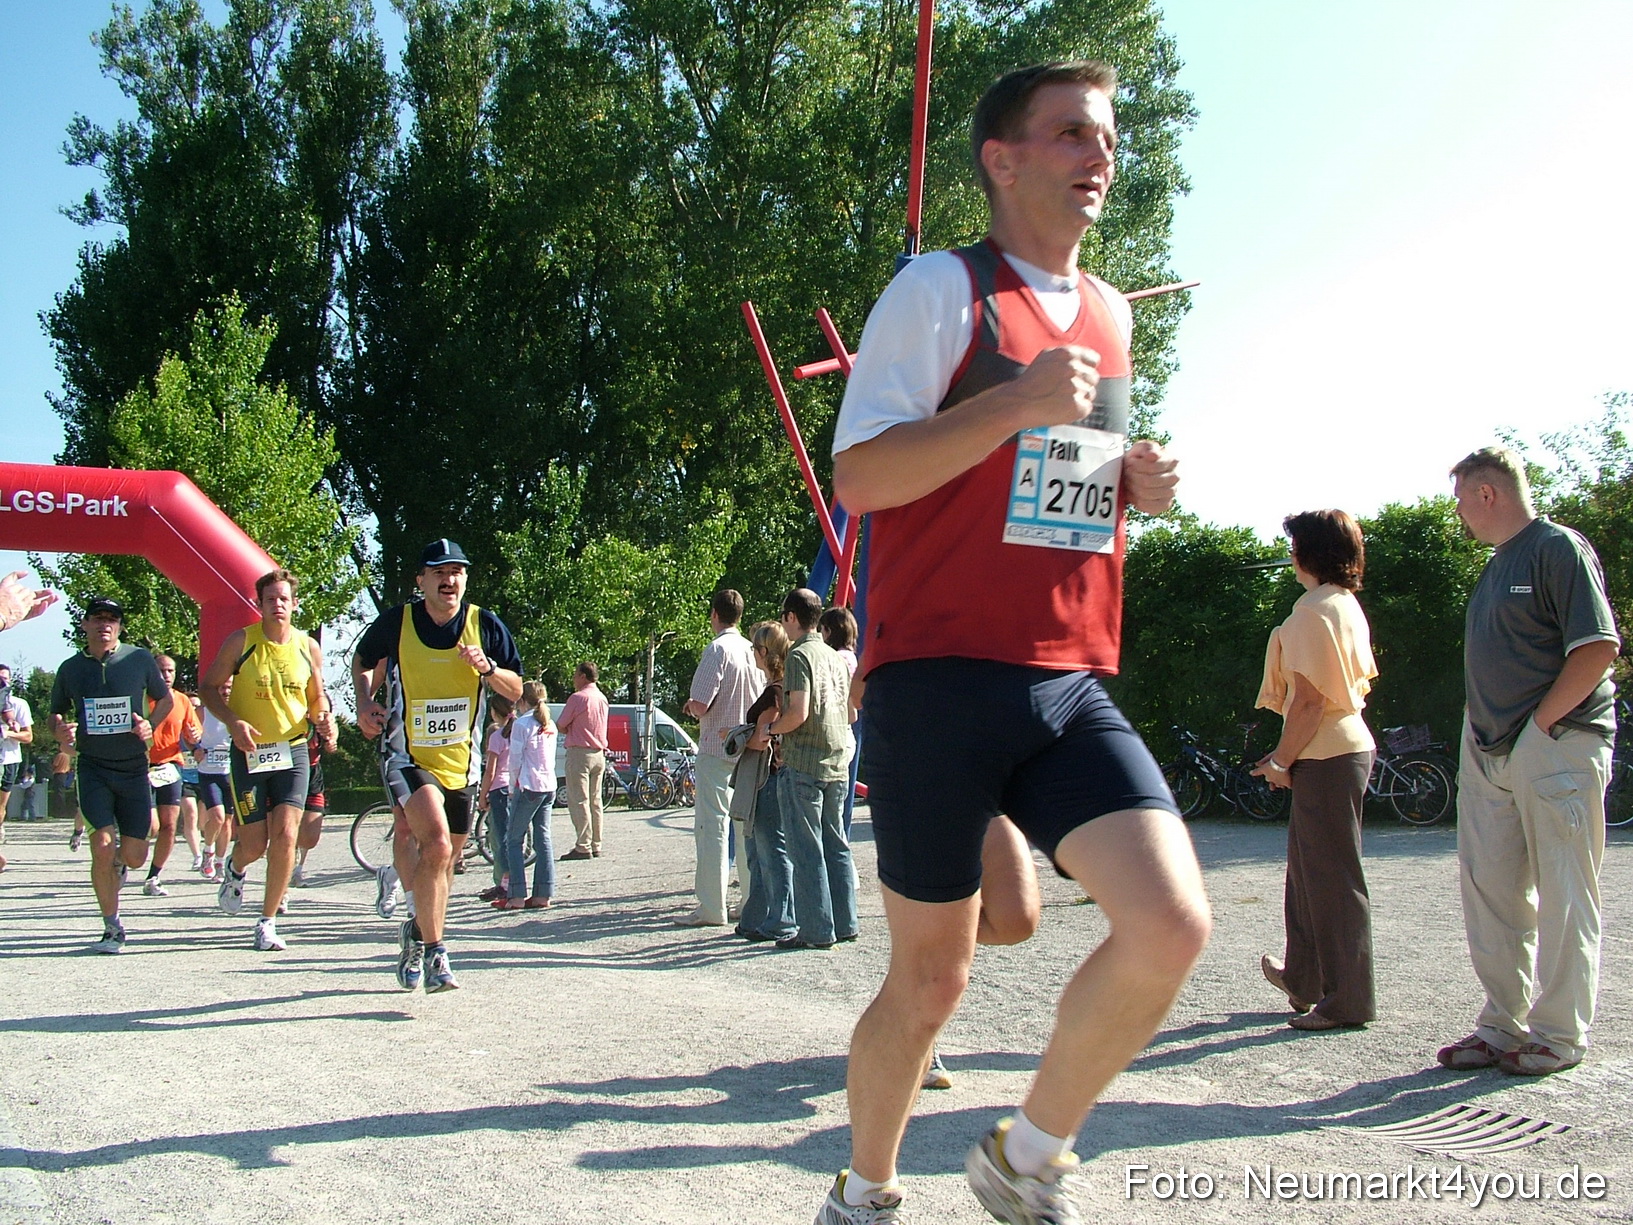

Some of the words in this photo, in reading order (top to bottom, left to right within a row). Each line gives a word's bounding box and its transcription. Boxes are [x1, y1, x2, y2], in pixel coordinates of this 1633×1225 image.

[1048, 439, 1081, 462] Falk
[1020, 468, 1034, 487] A
[1045, 478, 1114, 519] 2705
[96, 701, 126, 710] Leonhard
[426, 703, 467, 714] Alexander
[98, 713, 128, 725] 2037
[428, 718, 457, 734] 846
[256, 742, 277, 750] Robert
[259, 752, 281, 764] 652
